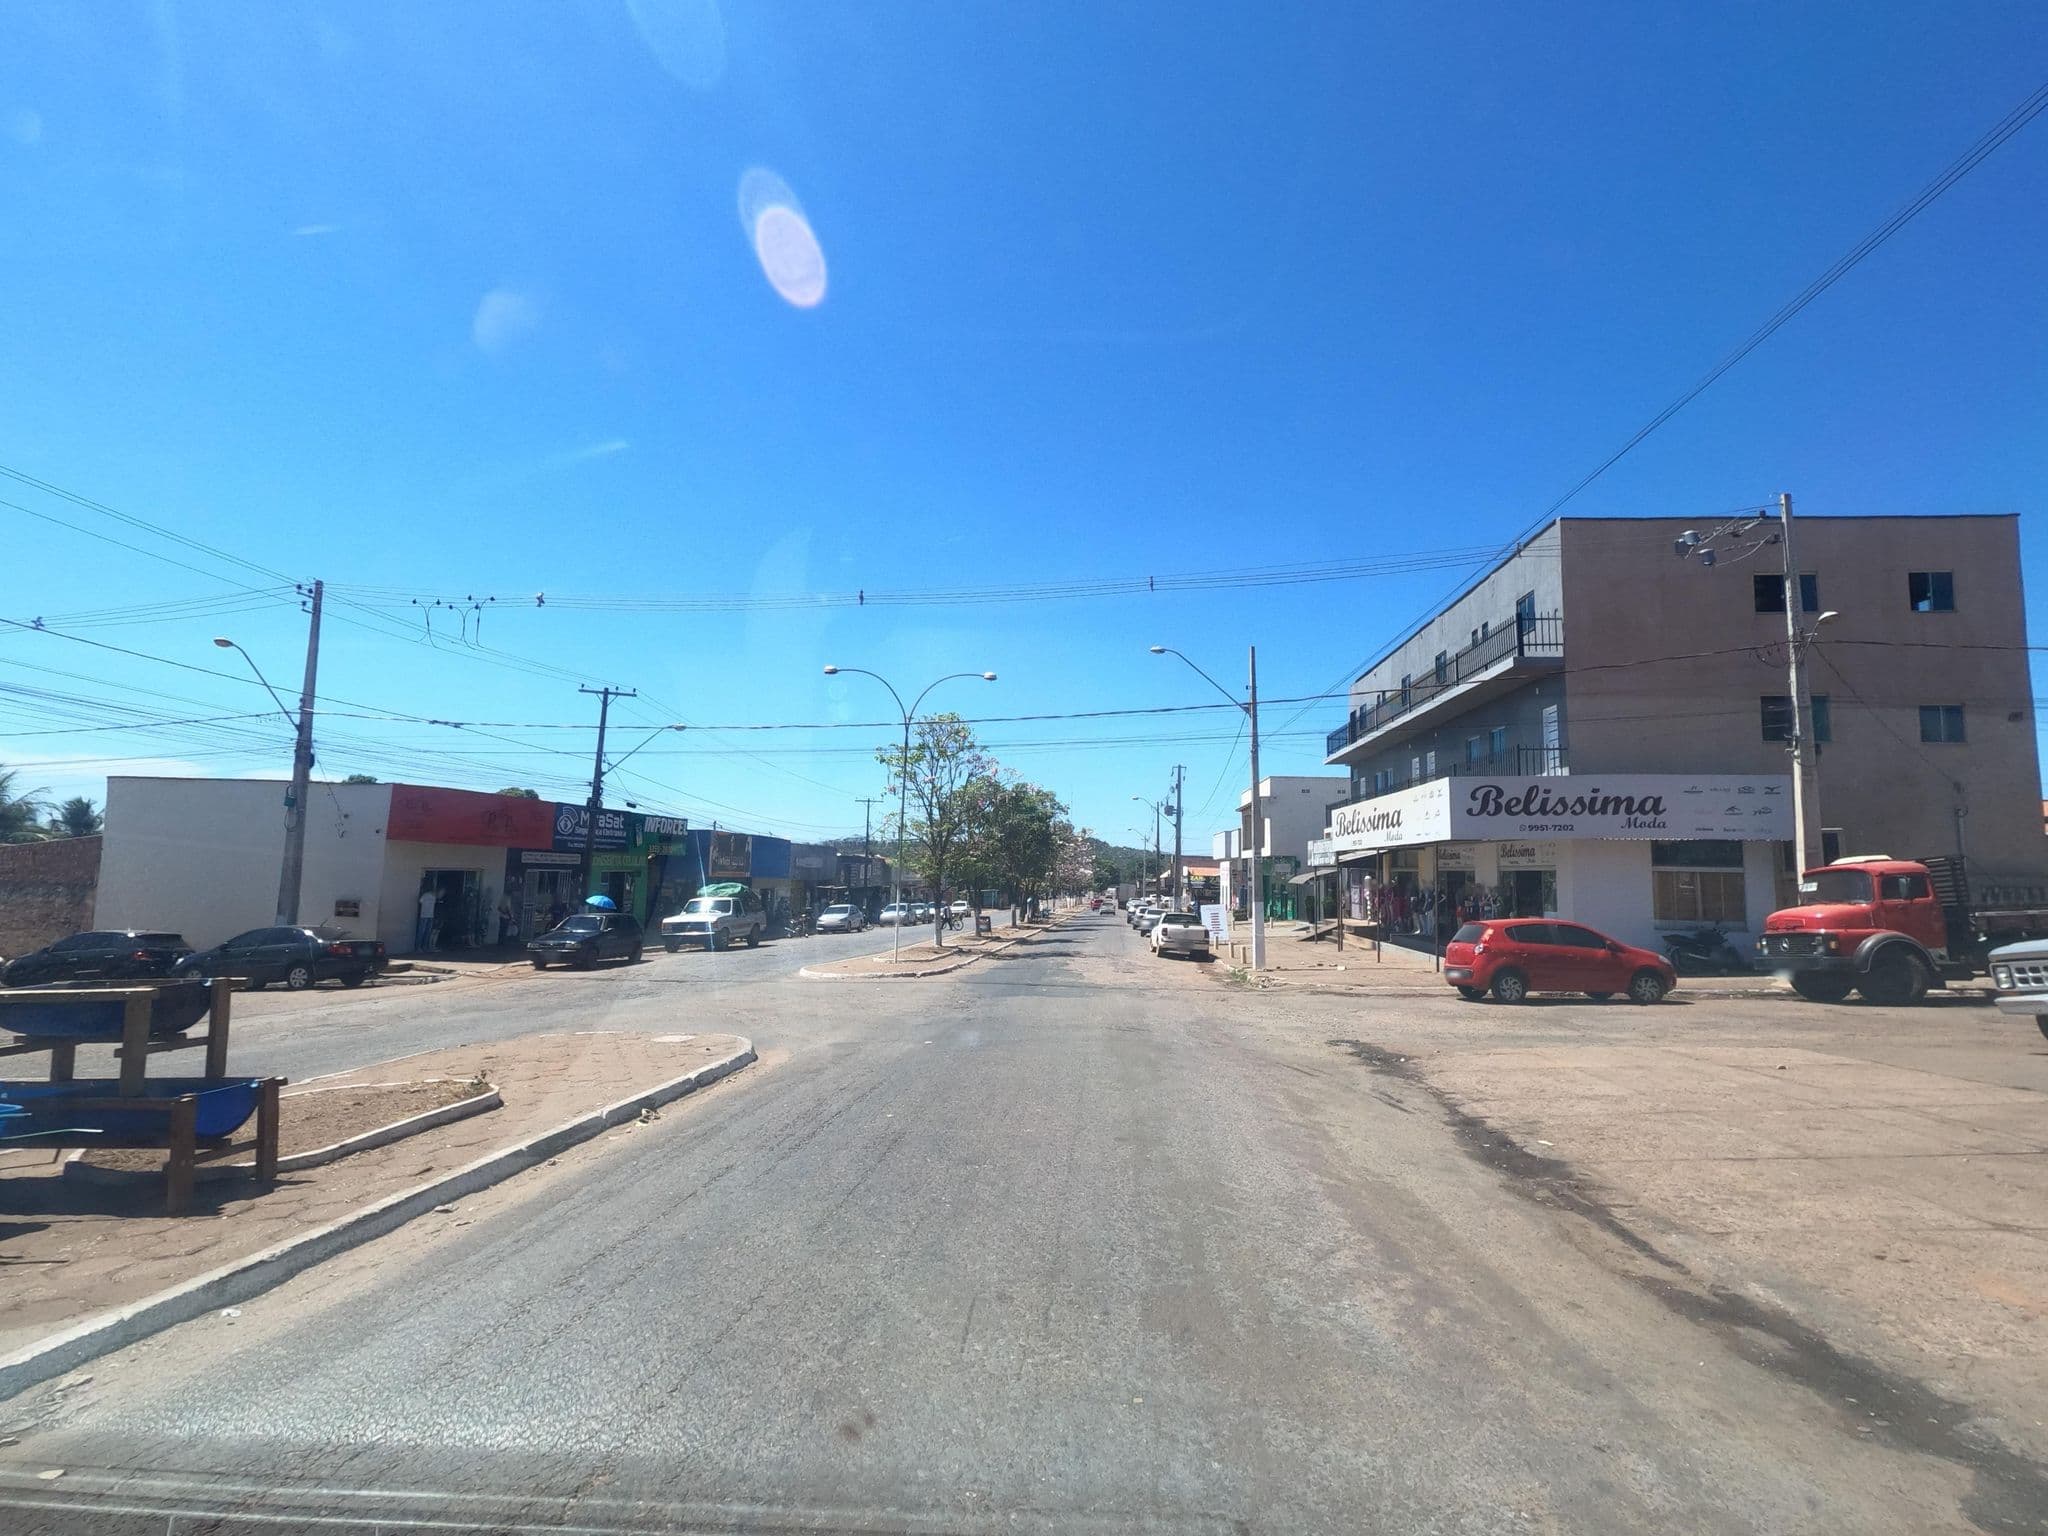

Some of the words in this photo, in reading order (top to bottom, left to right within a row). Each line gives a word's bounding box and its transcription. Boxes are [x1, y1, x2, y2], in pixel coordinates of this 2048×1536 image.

[1466, 784, 1667, 817] Belissima
[1336, 807, 1403, 837] Belissima
[1528, 823, 1574, 831] 9951-7202
[1620, 815, 1668, 830] Moda
